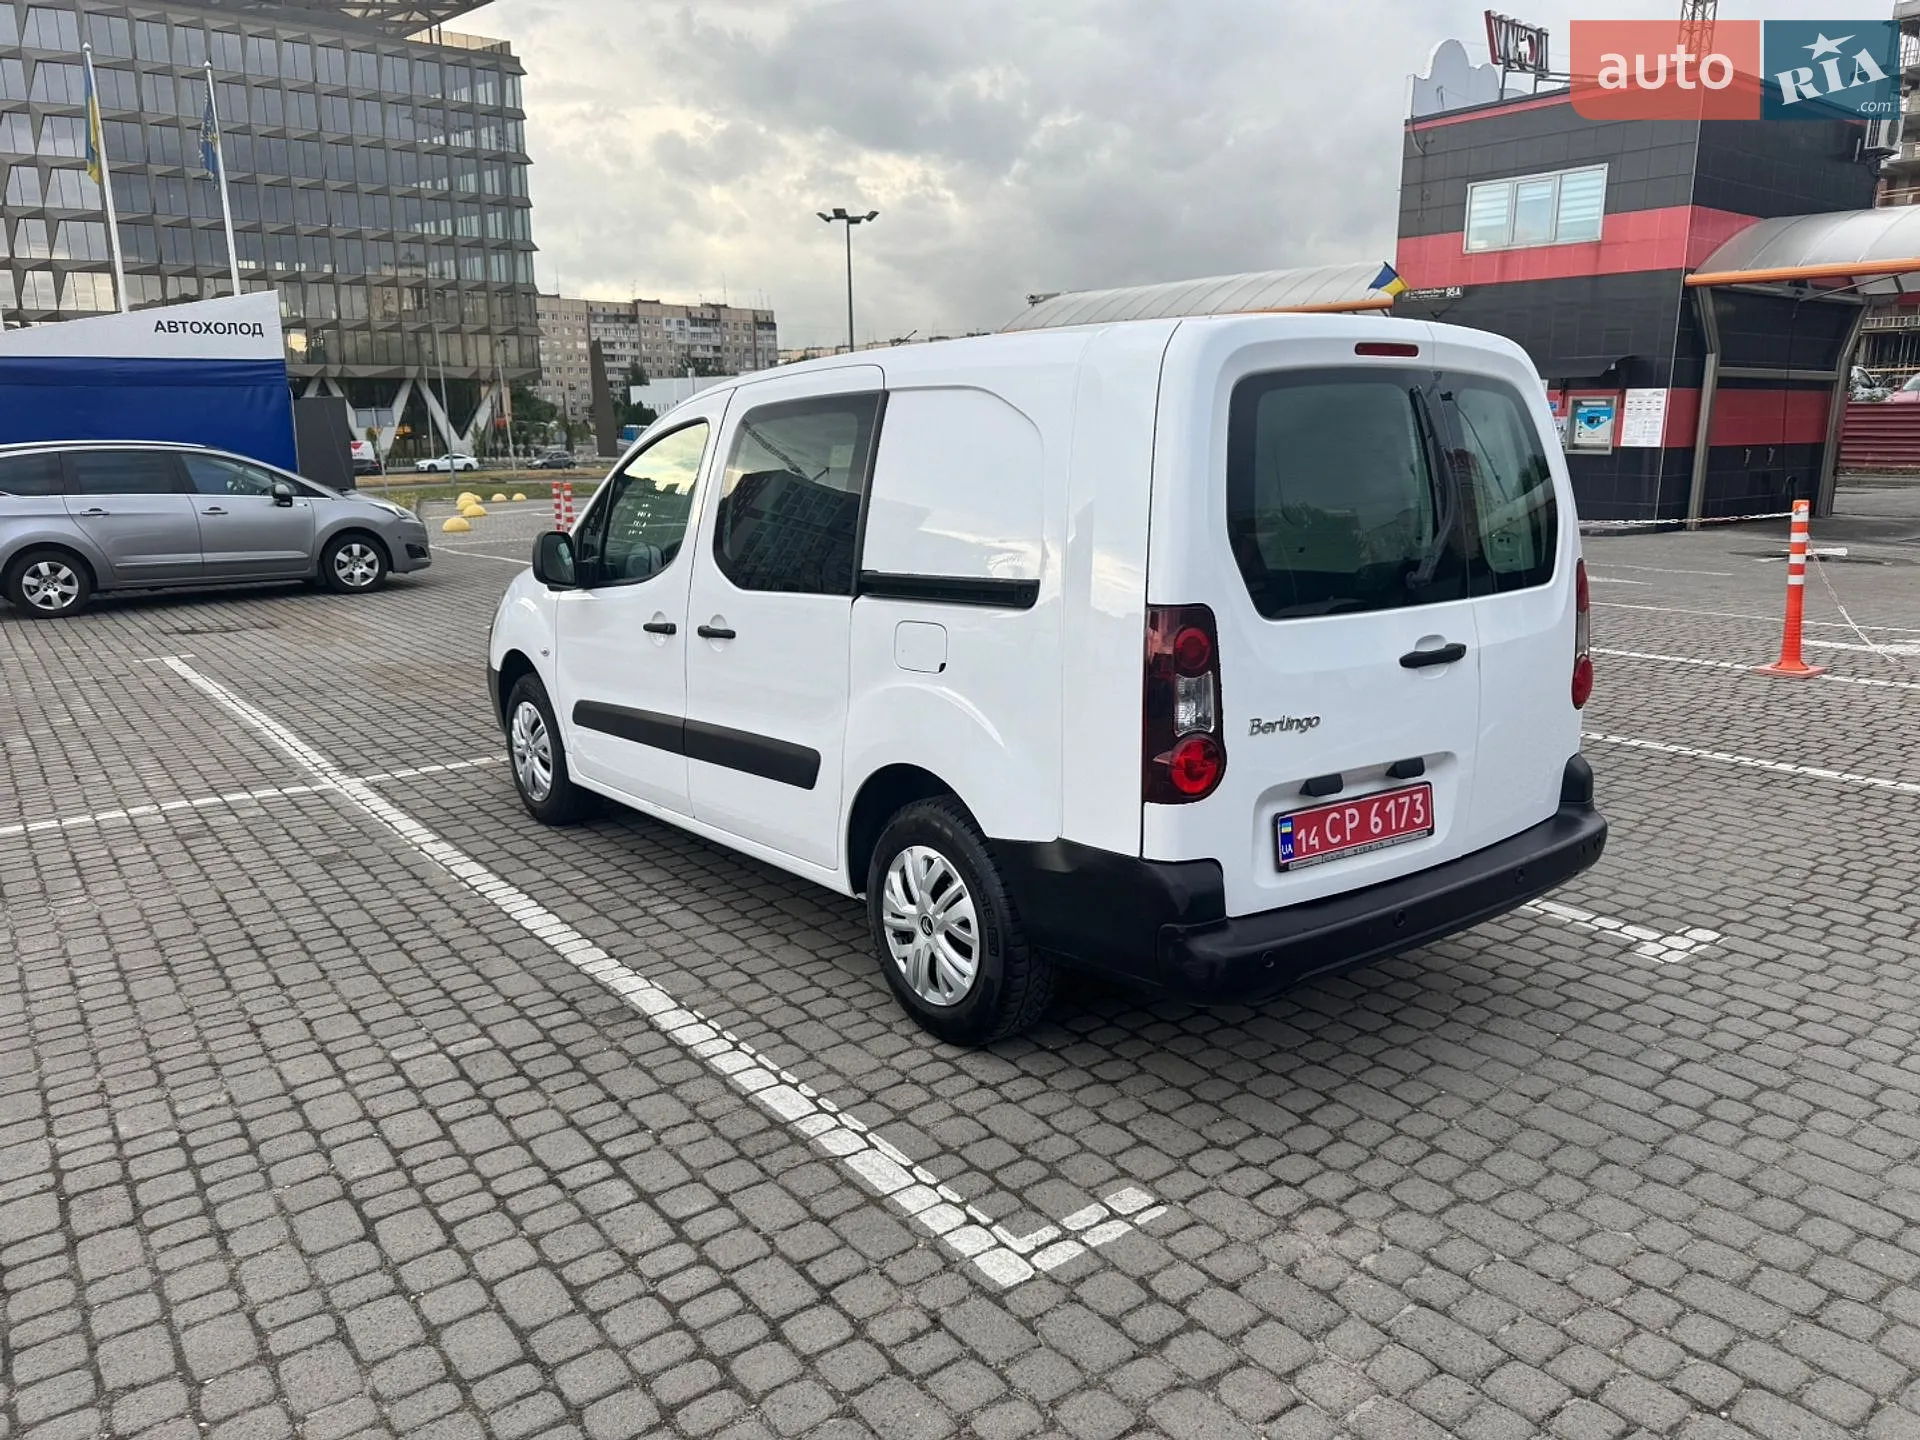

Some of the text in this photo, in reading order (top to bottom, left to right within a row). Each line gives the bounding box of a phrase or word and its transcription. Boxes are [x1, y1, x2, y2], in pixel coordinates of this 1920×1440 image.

[154, 319, 264, 338] АВТОХОЛОД
[1248, 714, 1321, 736] Berlingo
[1369, 793, 1425, 834] 6173
[1281, 843, 1294, 856] UA
